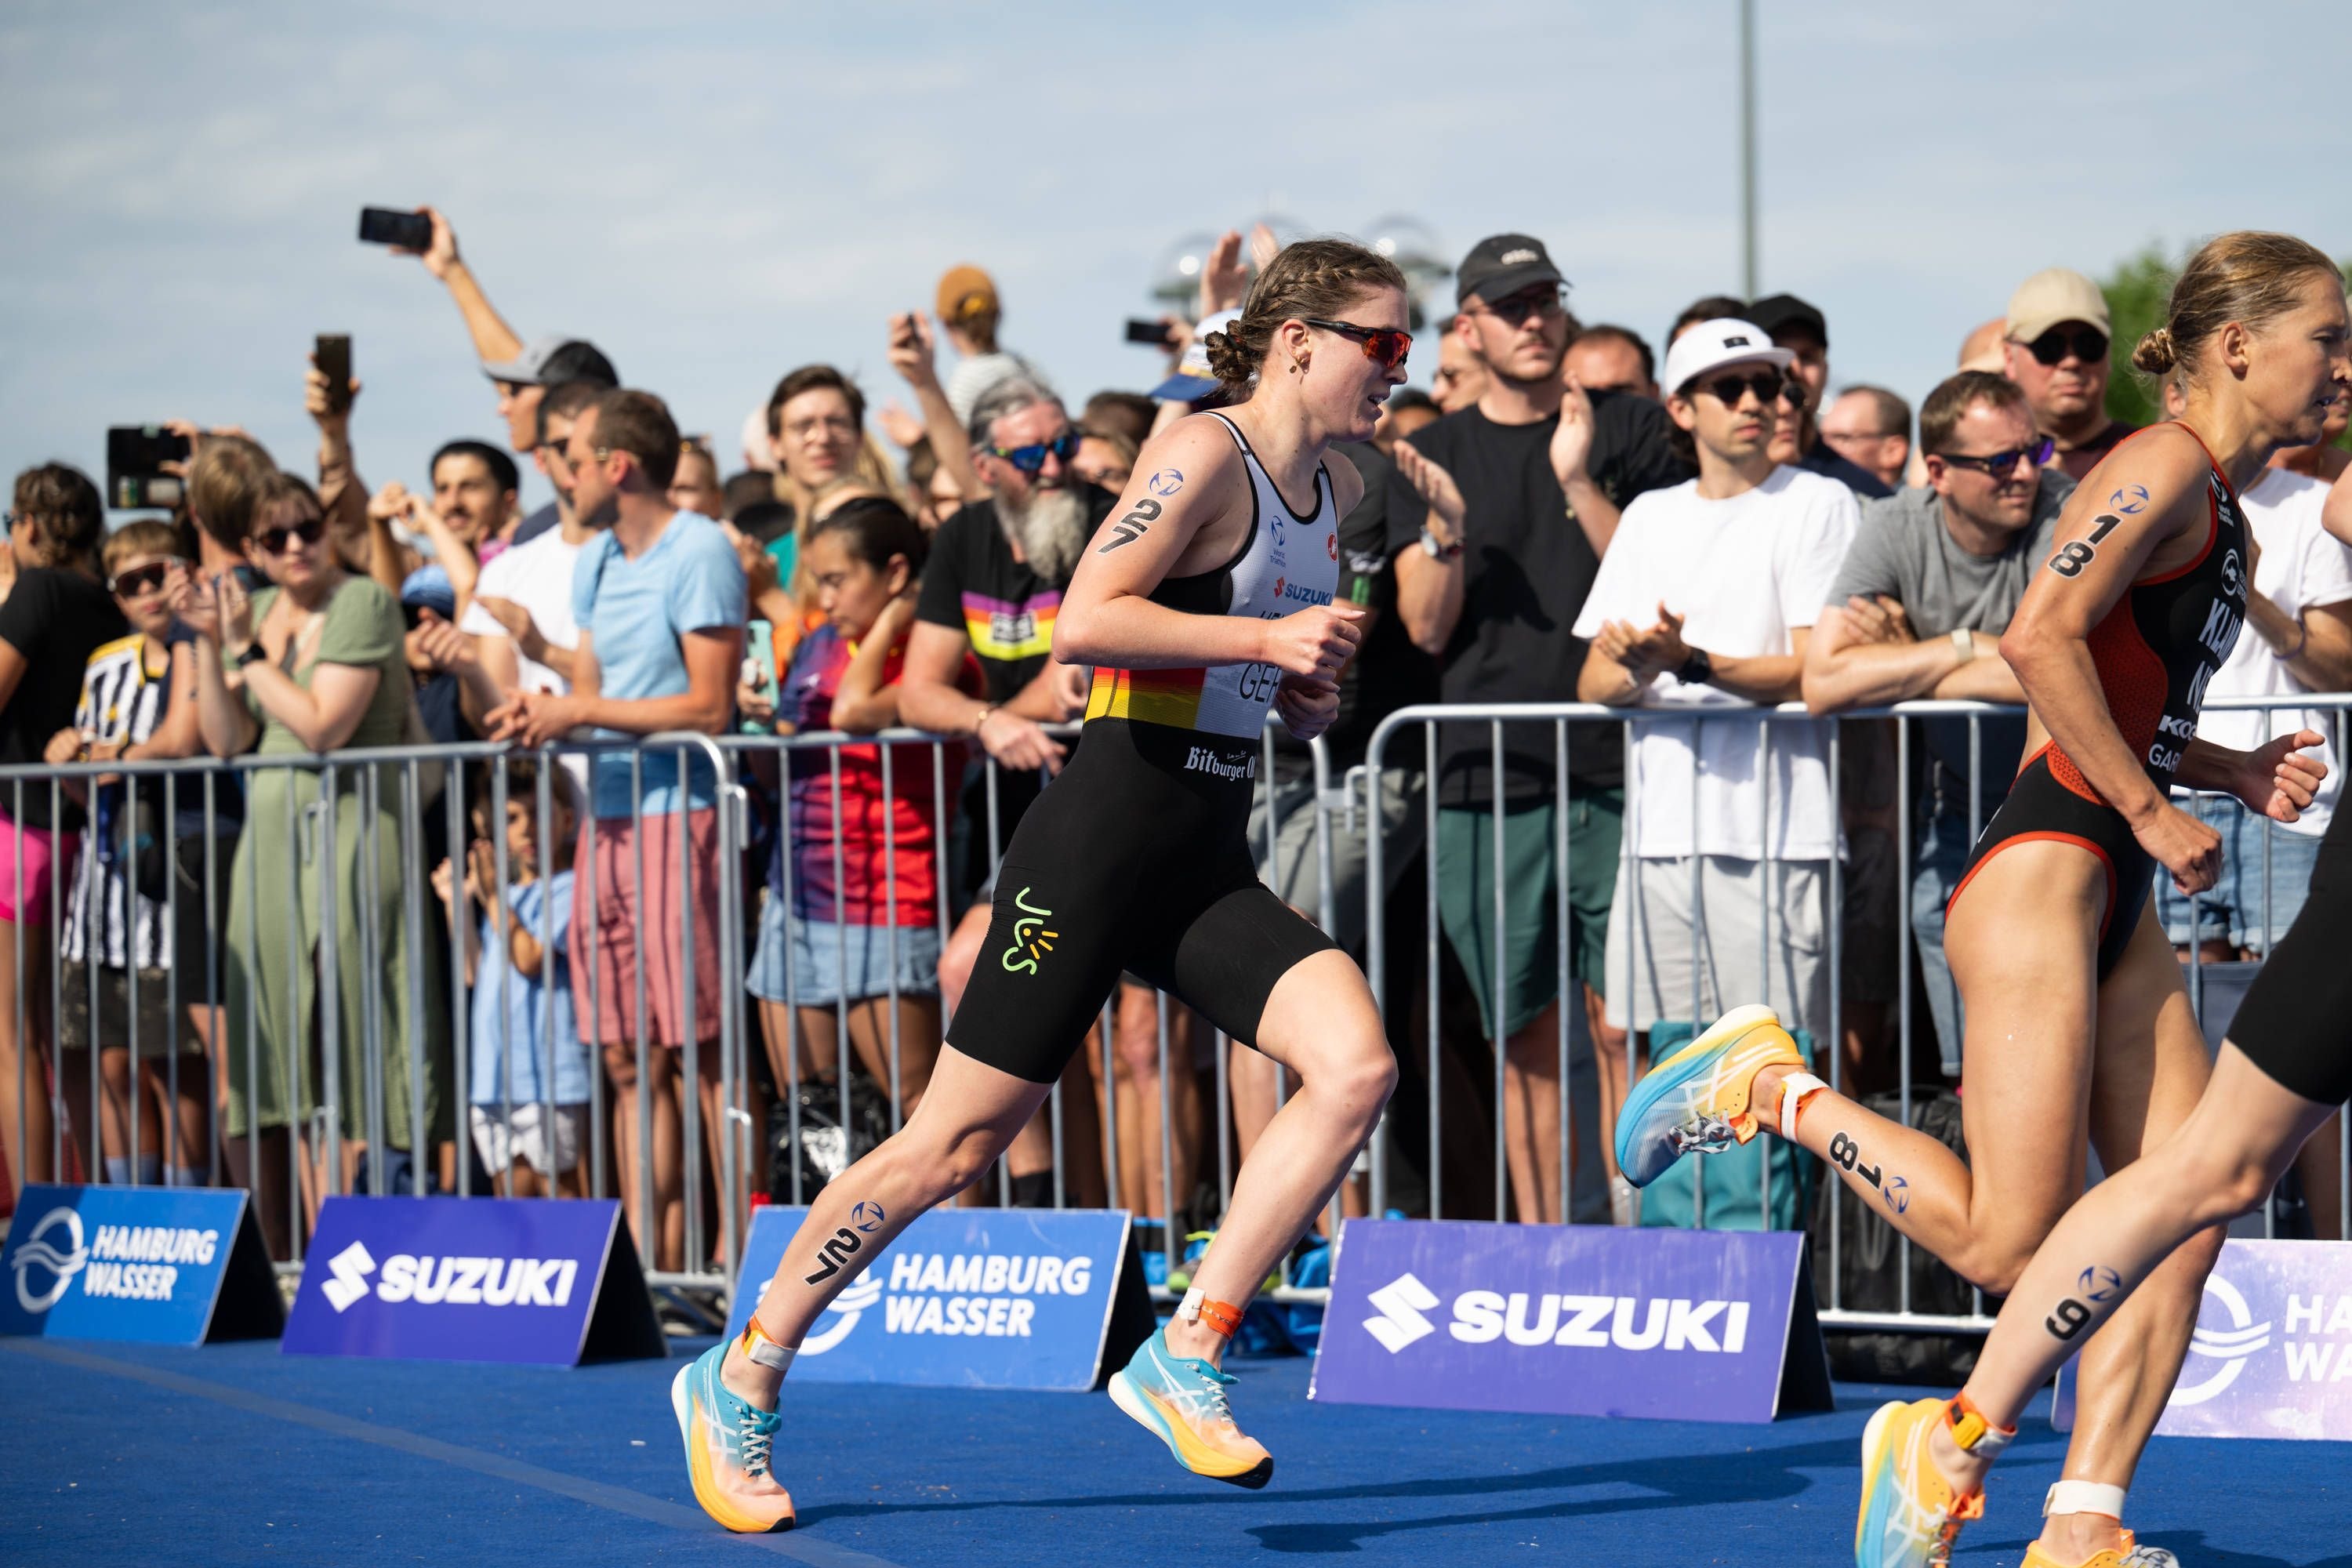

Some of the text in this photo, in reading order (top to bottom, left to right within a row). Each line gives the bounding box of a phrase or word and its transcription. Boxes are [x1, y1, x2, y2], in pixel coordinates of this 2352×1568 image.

[1272, 547, 1286, 559] World
[2049, 514, 2122, 579] 18
[1285, 583, 1333, 606] SUZUKI
[1184, 746, 1246, 782] Bitburger
[93, 1225, 219, 1266] HAMBURG
[84, 1261, 178, 1301] WASSER
[376, 1254, 579, 1307] SUZUKI
[888, 1254, 1092, 1296] HAMBURG
[885, 1296, 1035, 1337] WASSER
[1449, 1290, 1750, 1353] SUZUKI
